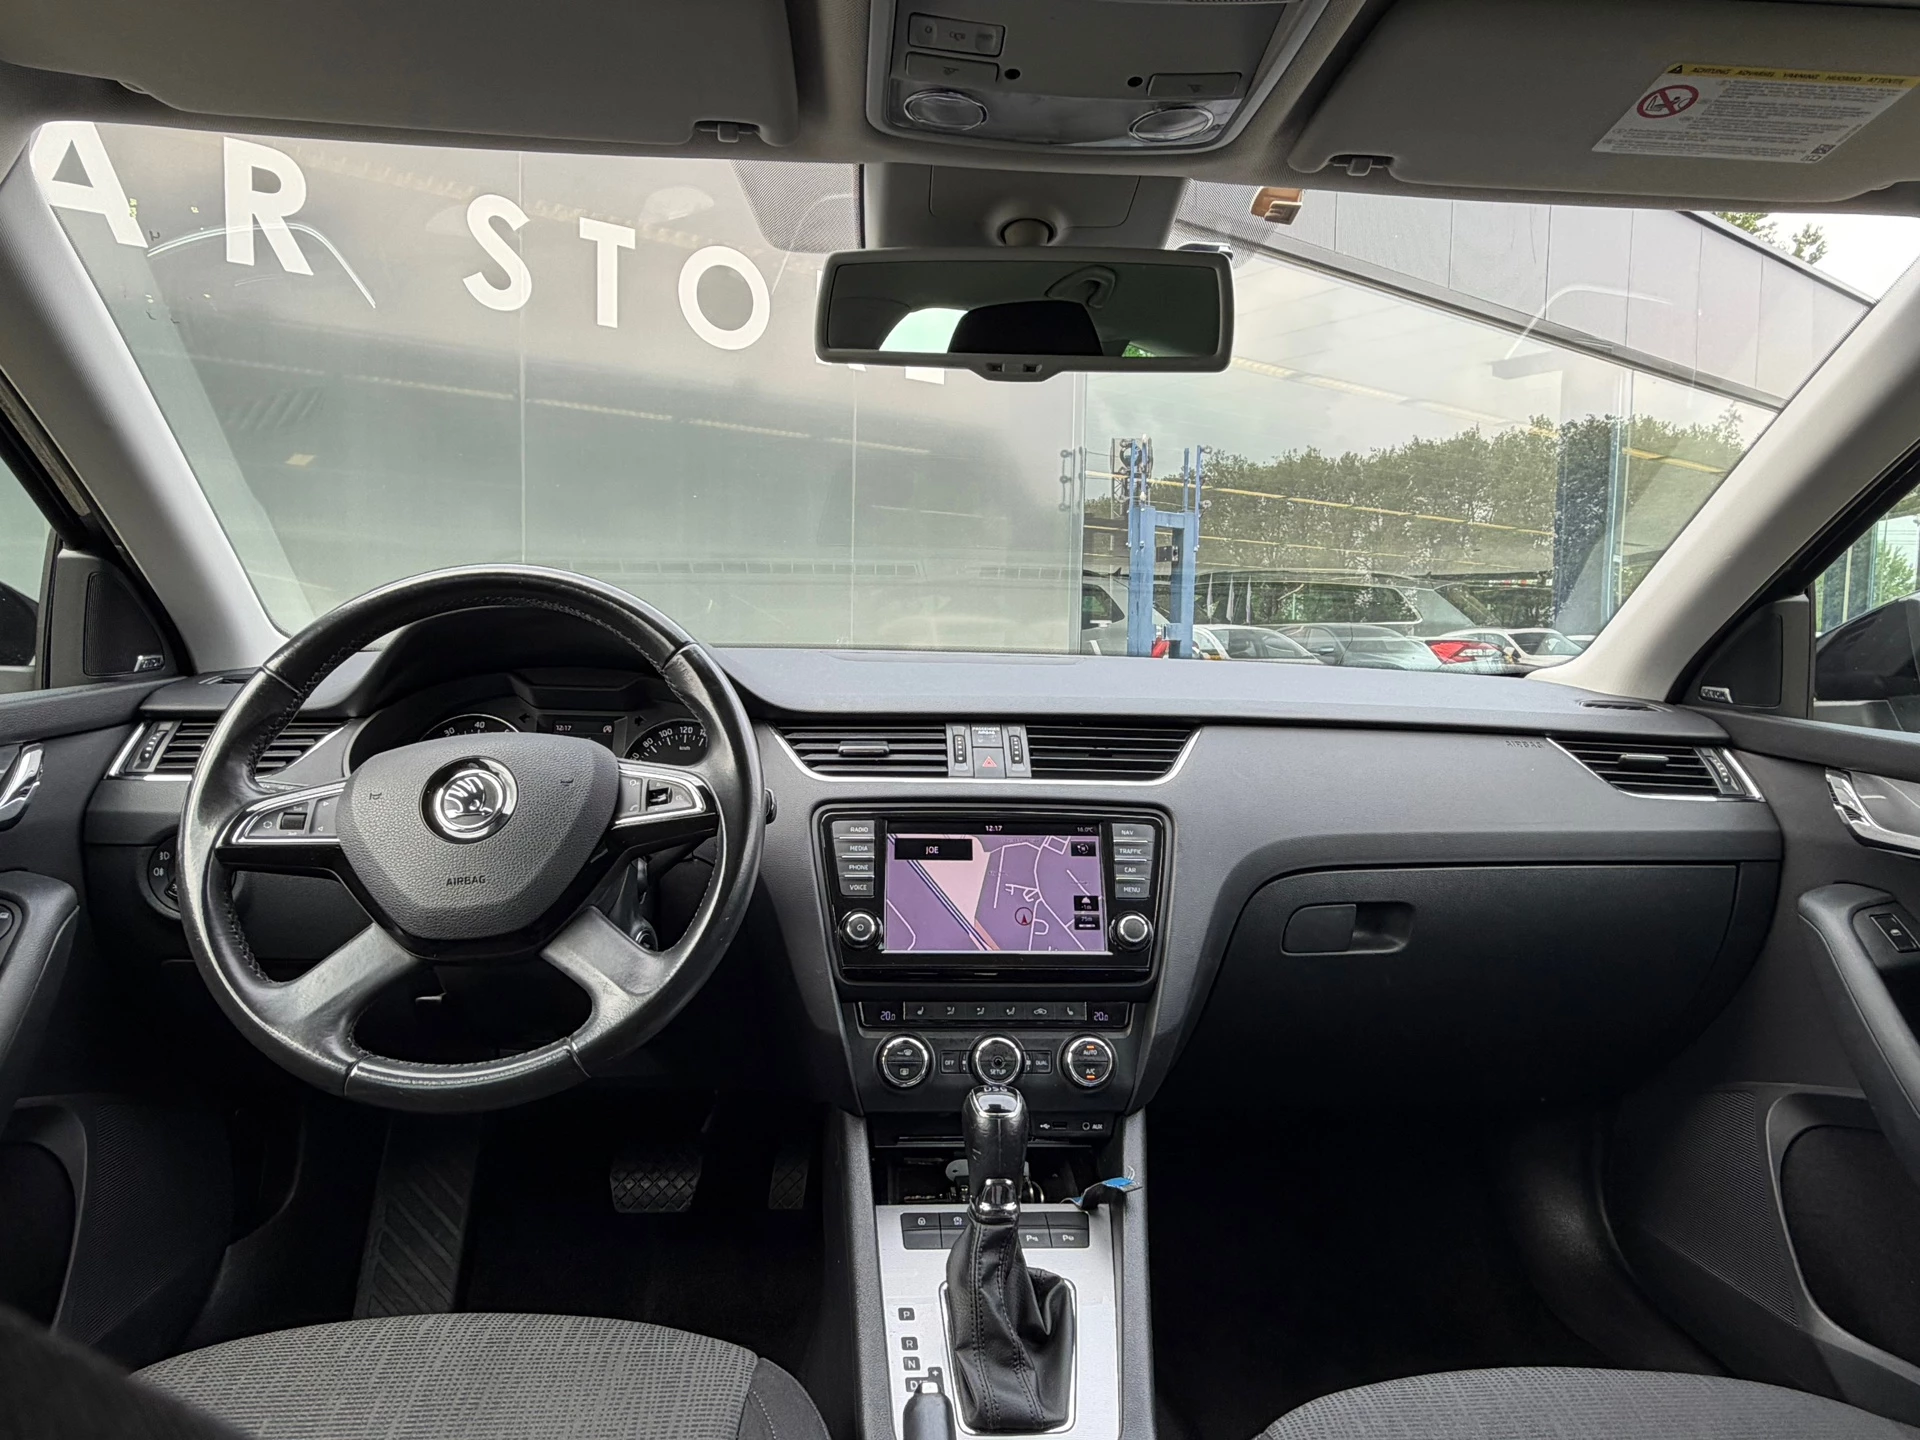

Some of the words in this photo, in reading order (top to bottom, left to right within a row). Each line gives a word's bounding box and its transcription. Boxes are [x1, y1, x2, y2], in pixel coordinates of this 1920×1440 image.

[444, 727, 455, 737] 30
[658, 728, 673, 737] 100
[680, 726, 693, 734] 120
[643, 737, 653, 748] 80
[925, 846, 939, 854] JOE
[446, 875, 486, 886] AIRBAG
[903, 1311, 910, 1319] P
[906, 1339, 913, 1348] R
[908, 1359, 916, 1369] N
